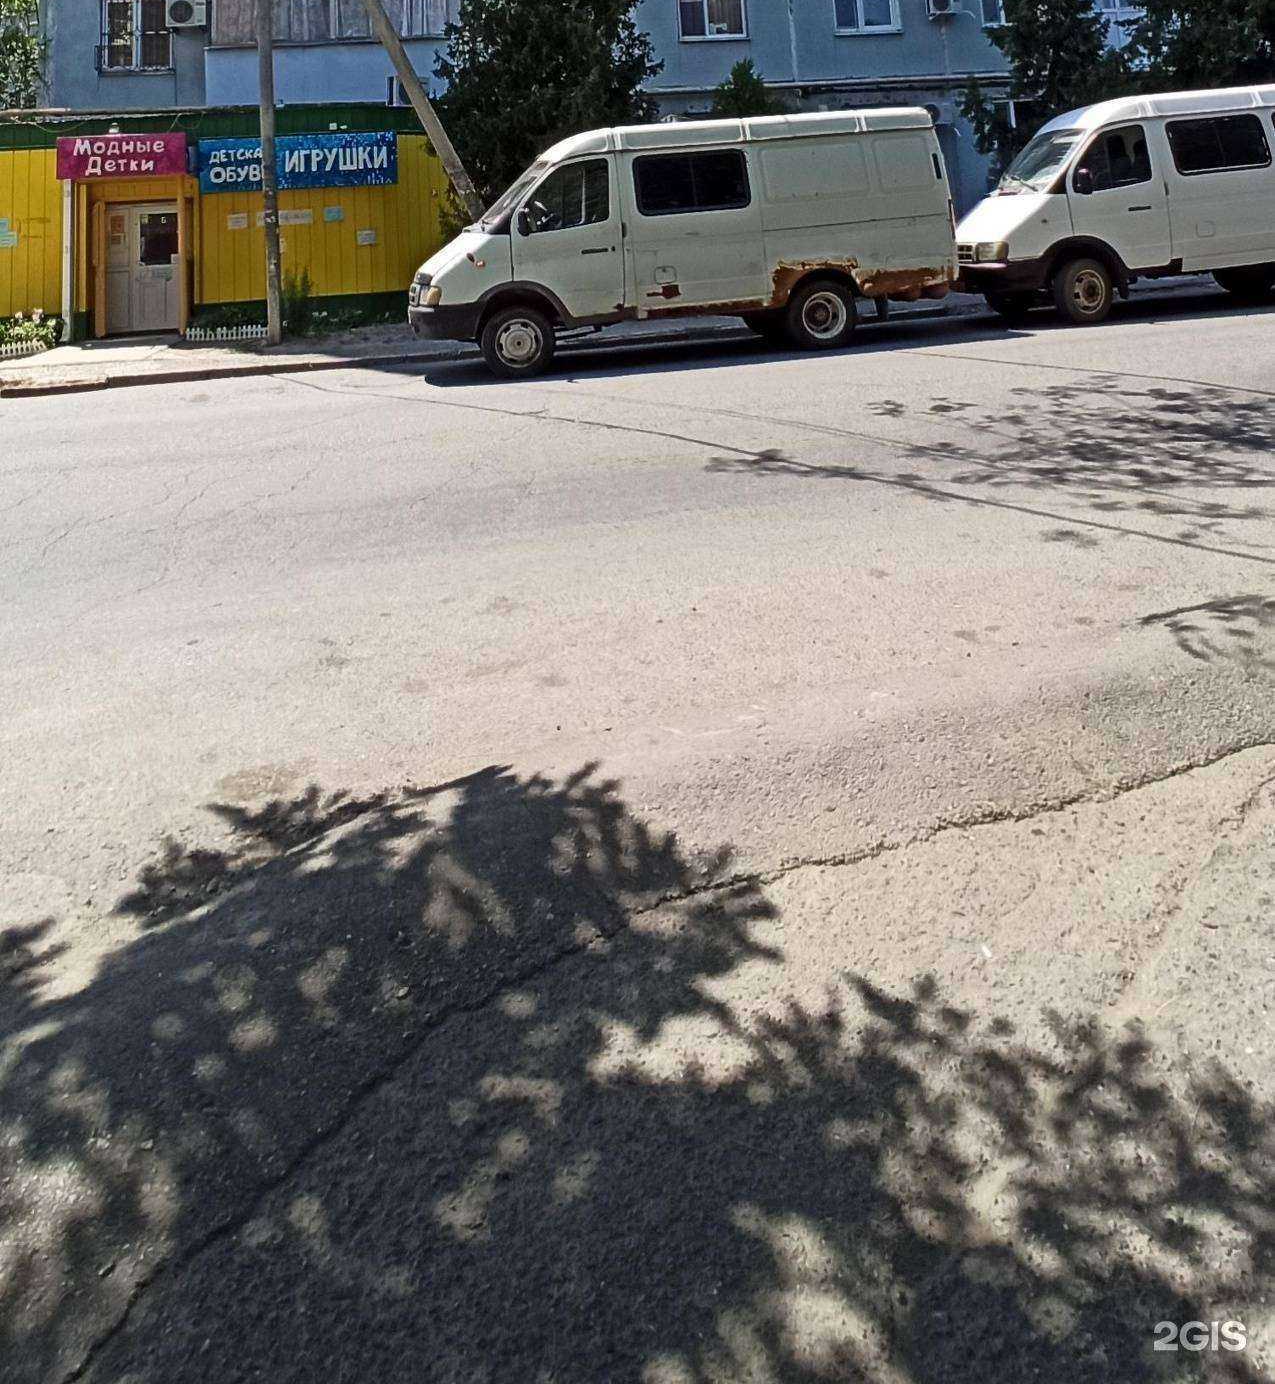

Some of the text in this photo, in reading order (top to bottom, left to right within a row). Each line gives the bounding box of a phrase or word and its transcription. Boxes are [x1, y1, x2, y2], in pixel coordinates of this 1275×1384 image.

[73, 138, 165, 156] Модные
[209, 147, 264, 164] ДЕТСКА
[85, 156, 154, 176] Детки
[285, 146, 388, 173] ИГРУШКИ
